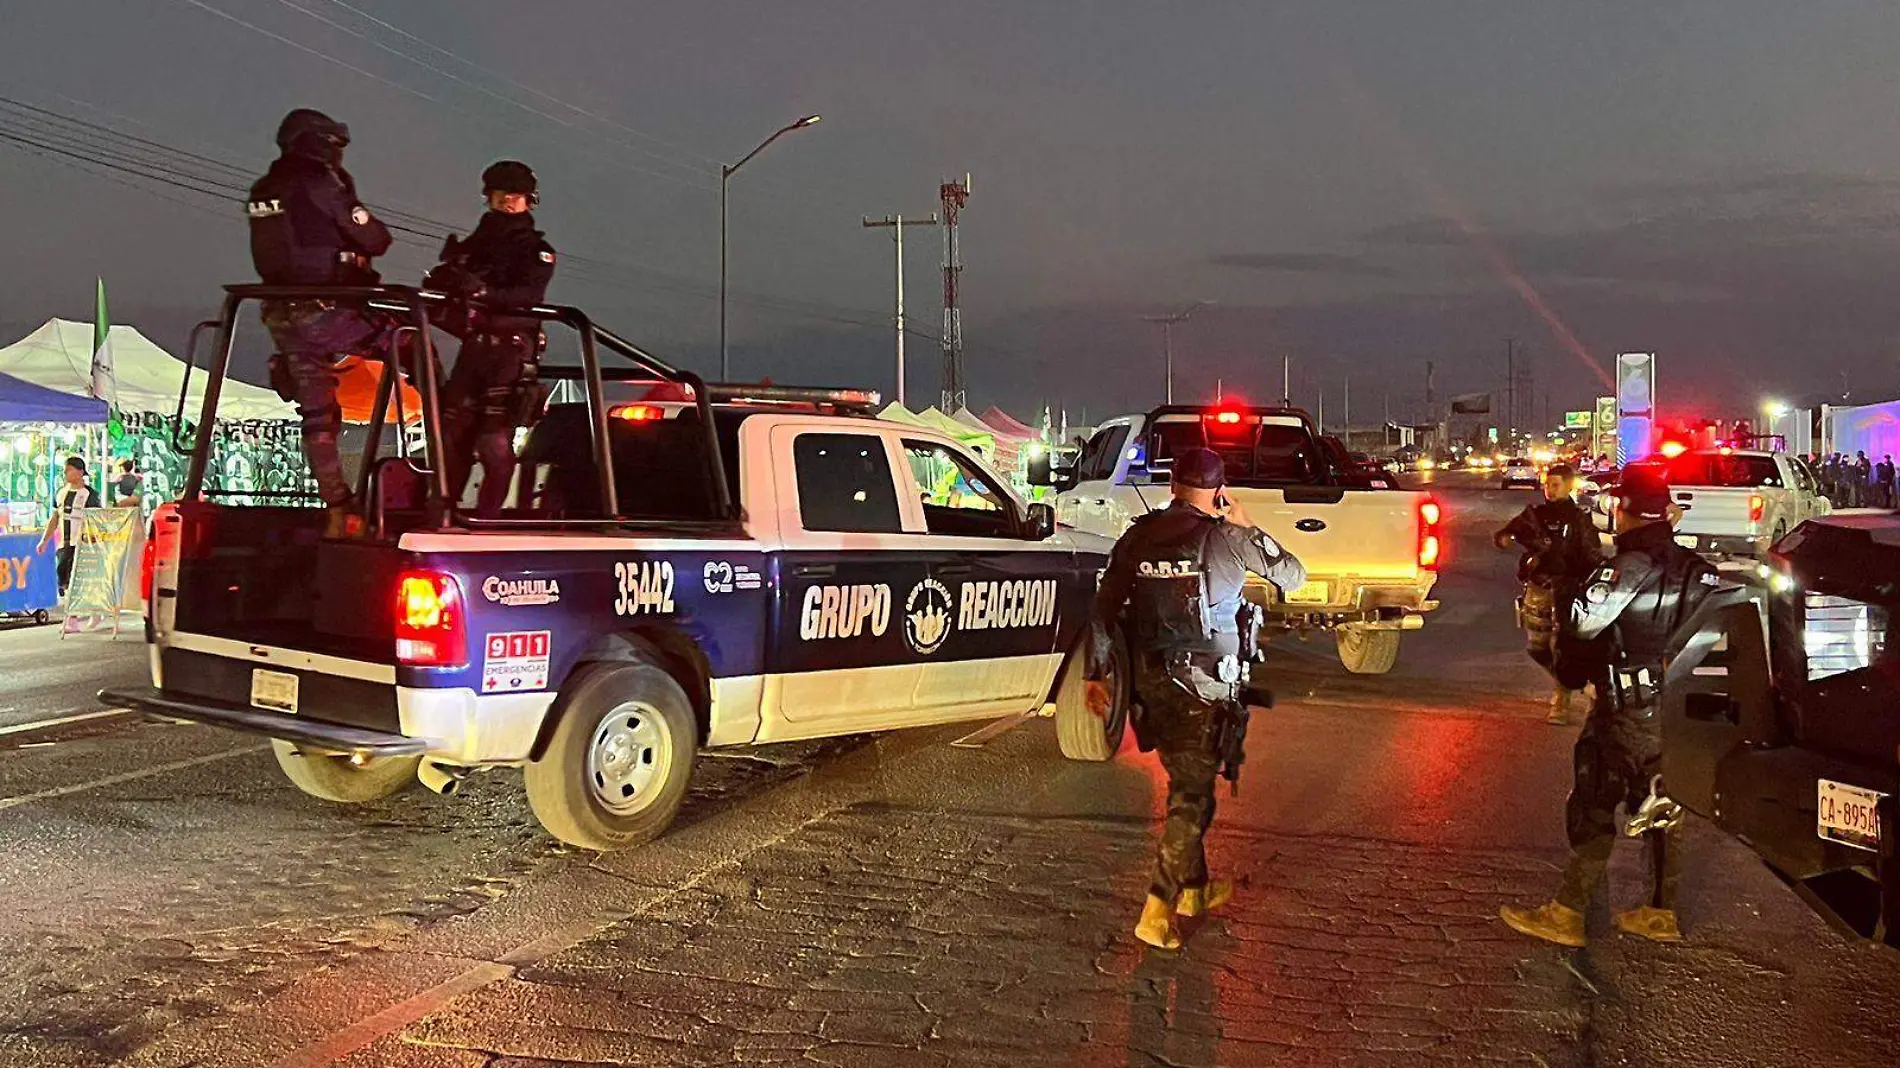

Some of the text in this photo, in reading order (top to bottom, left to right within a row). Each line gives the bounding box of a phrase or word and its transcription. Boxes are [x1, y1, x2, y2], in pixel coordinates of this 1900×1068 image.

[482, 576, 560, 602] COAHUILA
[614, 561, 675, 616] 35442
[703, 561, 734, 594] C2
[801, 582, 892, 641] GRUPO
[958, 579, 1057, 631] REACCION
[490, 636, 545, 657] 911
[485, 663, 547, 676] EMERGENCIAS
